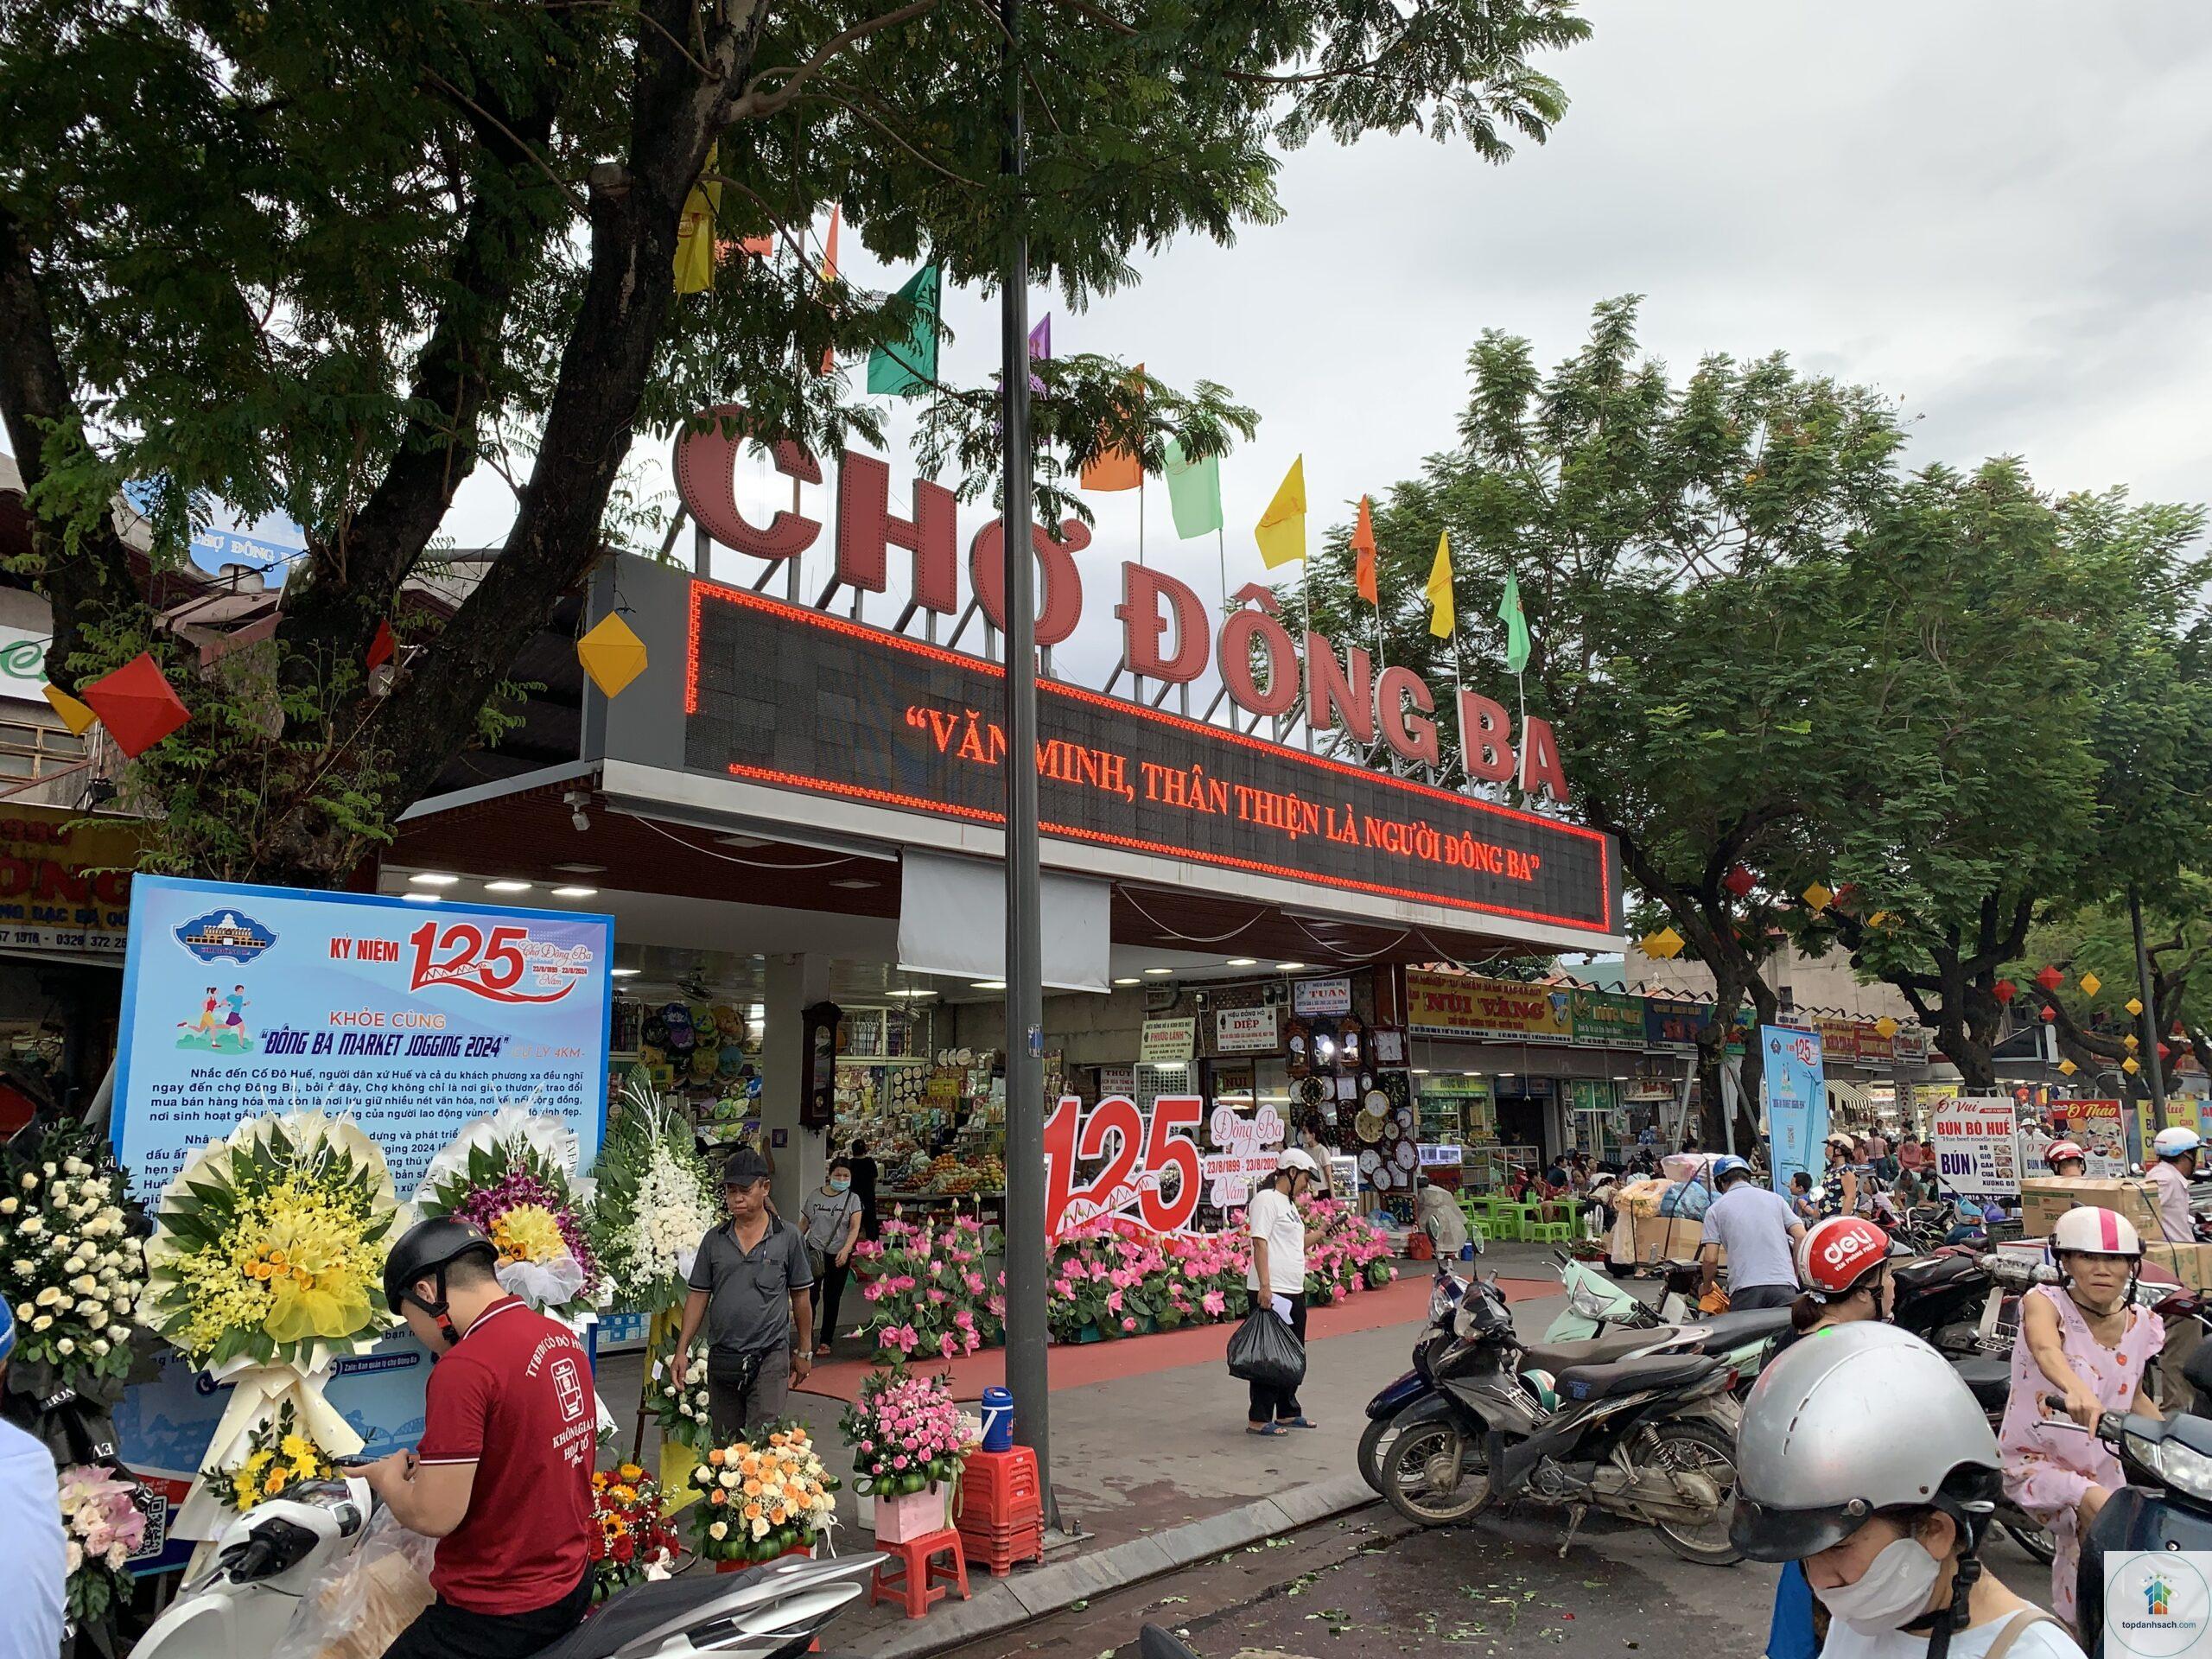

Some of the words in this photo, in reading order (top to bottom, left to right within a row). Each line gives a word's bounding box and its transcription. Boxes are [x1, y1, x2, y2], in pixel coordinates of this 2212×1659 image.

[231, 540, 275, 562] ĐÔNG
[1115, 561, 1440, 767] ĐÔNG
[1456, 689, 1570, 804] BA
[1141, 763, 1230, 816] THÂN
[1235, 783, 1320, 841] THIỆN
[1325, 803, 1360, 846] LÀ
[1363, 815, 1442, 863] NGƯỜI
[1444, 830, 1504, 874] ĐÔNG
[1506, 848, 1541, 881] BA”
[329, 932, 353, 959] KỶ
[357, 937, 400, 963] NIỆM
[410, 921, 529, 992] 125
[1424, 991, 1472, 1014] NÚI
[1478, 995, 1545, 1020] VÀNG
[329, 1007, 385, 1027] KHỎE
[391, 1009, 446, 1029] CÙNG
[1234, 1017, 1259, 1031] DIỆP
[311, 1033, 333, 1055] BA
[338, 1033, 404, 1057] MARKET
[404, 1034, 462, 1058] JOGGING
[1796, 1038, 1811, 1061] 125
[190, 1069, 221, 1078] Nhắc
[226, 1068, 247, 1078] đến
[251, 1067, 269, 1078] Cố
[271, 1069, 287, 1078] Đô
[290, 1068, 315, 1080] Huế,
[319, 1069, 349, 1081] người
[353, 1070, 372, 1079] dân
[376, 1069, 390, 1079] xứ
[392, 1069, 412, 1079] Huế
[415, 1070, 427, 1079] và
[429, 1069, 442, 1079] cả
[460, 1071, 489, 1080] khách
[492, 1071, 527, 1082] phương
[543, 1071, 561, 1080] đều
[152, 1084, 184, 1095] ngay
[188, 1082, 213, 1092] đến
[217, 1083, 241, 1094] chợ
[245, 1082, 277, 1095] Đông
[305, 1082, 324, 1093] bởi
[338, 1083, 361, 1095] đây,
[365, 1084, 388, 1095] Chợ
[391, 1083, 425, 1095] không
[429, 1082, 445, 1092] chỉ
[448, 1083, 457, 1092] là
[461, 1084, 477, 1092] nơi
[480, 1084, 502, 1095] giao
[568, 1082, 583, 1092] đổi
[150, 1098, 177, 1107] mua
[181, 1096, 204, 1107] bán
[208, 1096, 238, 1109] hàng
[242, 1096, 264, 1106] hóa
[267, 1096, 284, 1106] mà
[312, 1096, 322, 1106] là
[325, 1096, 342, 1106] nơi
[365, 1095, 383, 1108] giữ
[385, 1095, 412, 1105] nhiều
[416, 1095, 433, 1105] nét
[435, 1096, 453, 1105] văn
[456, 1095, 477, 1107] hóa,
[480, 1096, 495, 1104] nơi
[556, 1094, 582, 1107] đồng,
[2082, 1102, 2117, 1117] Thảo
[149, 1111, 169, 1121] nơi
[173, 1110, 200, 1121] sinh
[204, 1110, 231, 1122] hoạt
[365, 1109, 384, 1119] của
[387, 1109, 416, 1121] người
[419, 1109, 435, 1118] lao
[438, 1109, 462, 1120] động
[1214, 1110, 1257, 1158] Đông
[1256, 1110, 1281, 1139] Ba
[1936, 1119, 1961, 1135] BÚN
[1966, 1120, 1982, 1135] BÒ
[1986, 1116, 2011, 1135] HUẾ
[369, 1131, 397, 1141] dựng
[400, 1130, 412, 1140] và
[415, 1130, 439, 1141] phát
[146, 1148, 169, 1160] dấu
[411, 1144, 435, 1154] 2024
[145, 1166, 168, 1176] hẹn
[405, 1156, 423, 1166] thú
[1044, 1097, 1203, 1246] 125
[1207, 1160, 1241, 1173] 23/8/1899
[1941, 1150, 1971, 1175] BÚN
[395, 1169, 414, 1179] bản
[401, 1182, 414, 1192] xứ
[1214, 1173, 1245, 1202] Năm
[1824, 1226, 1873, 1264] deli
[385, 1331, 404, 1340] bạn
[555, 1334, 569, 1348] ĐÔ
